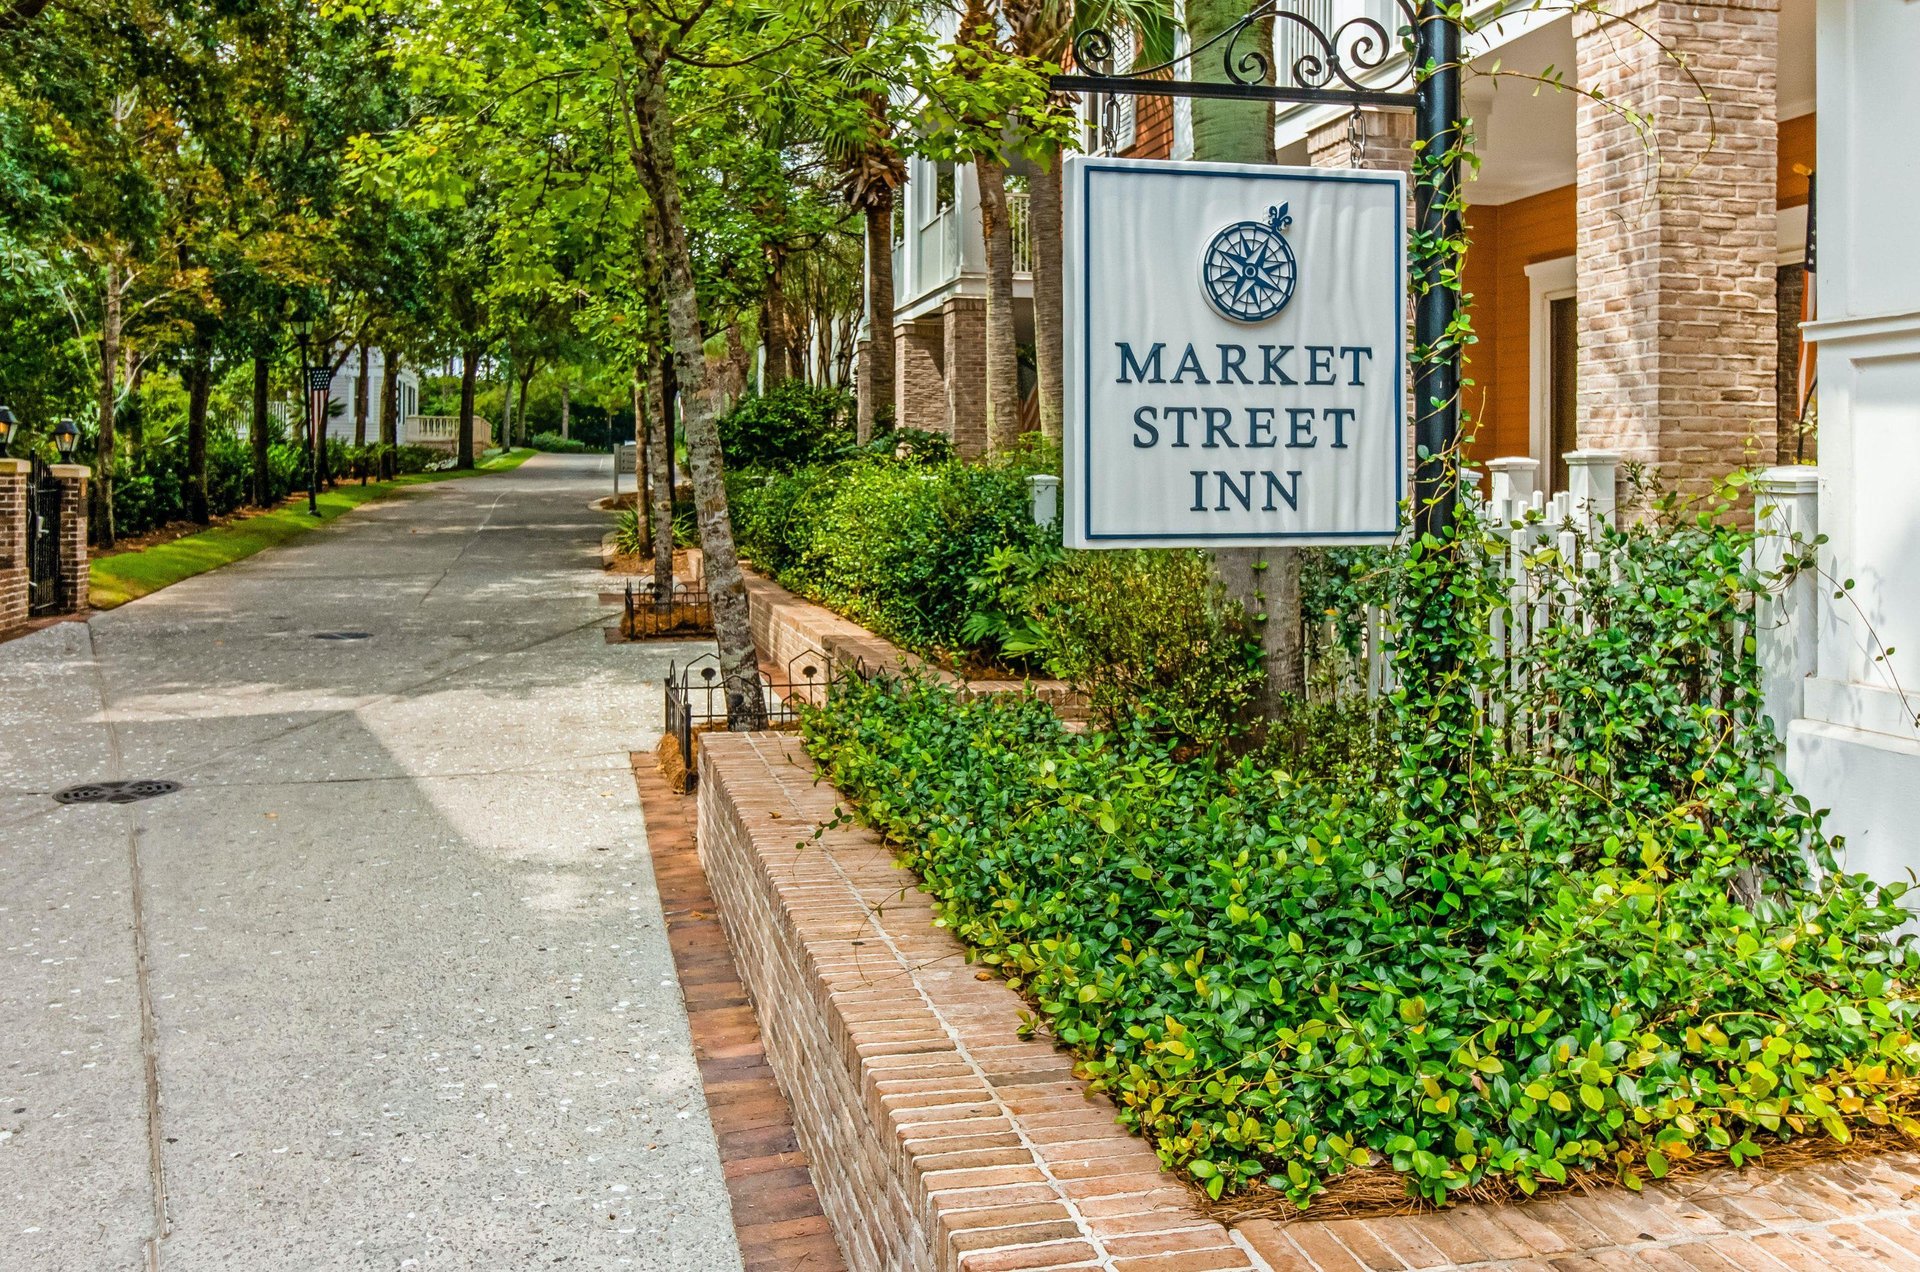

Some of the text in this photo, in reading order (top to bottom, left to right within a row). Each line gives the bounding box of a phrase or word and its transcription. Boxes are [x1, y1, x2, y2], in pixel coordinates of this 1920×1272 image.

[1114, 341, 1373, 386] MARKET
[1133, 405, 1356, 449] STREET
[1189, 470, 1303, 513] INN
